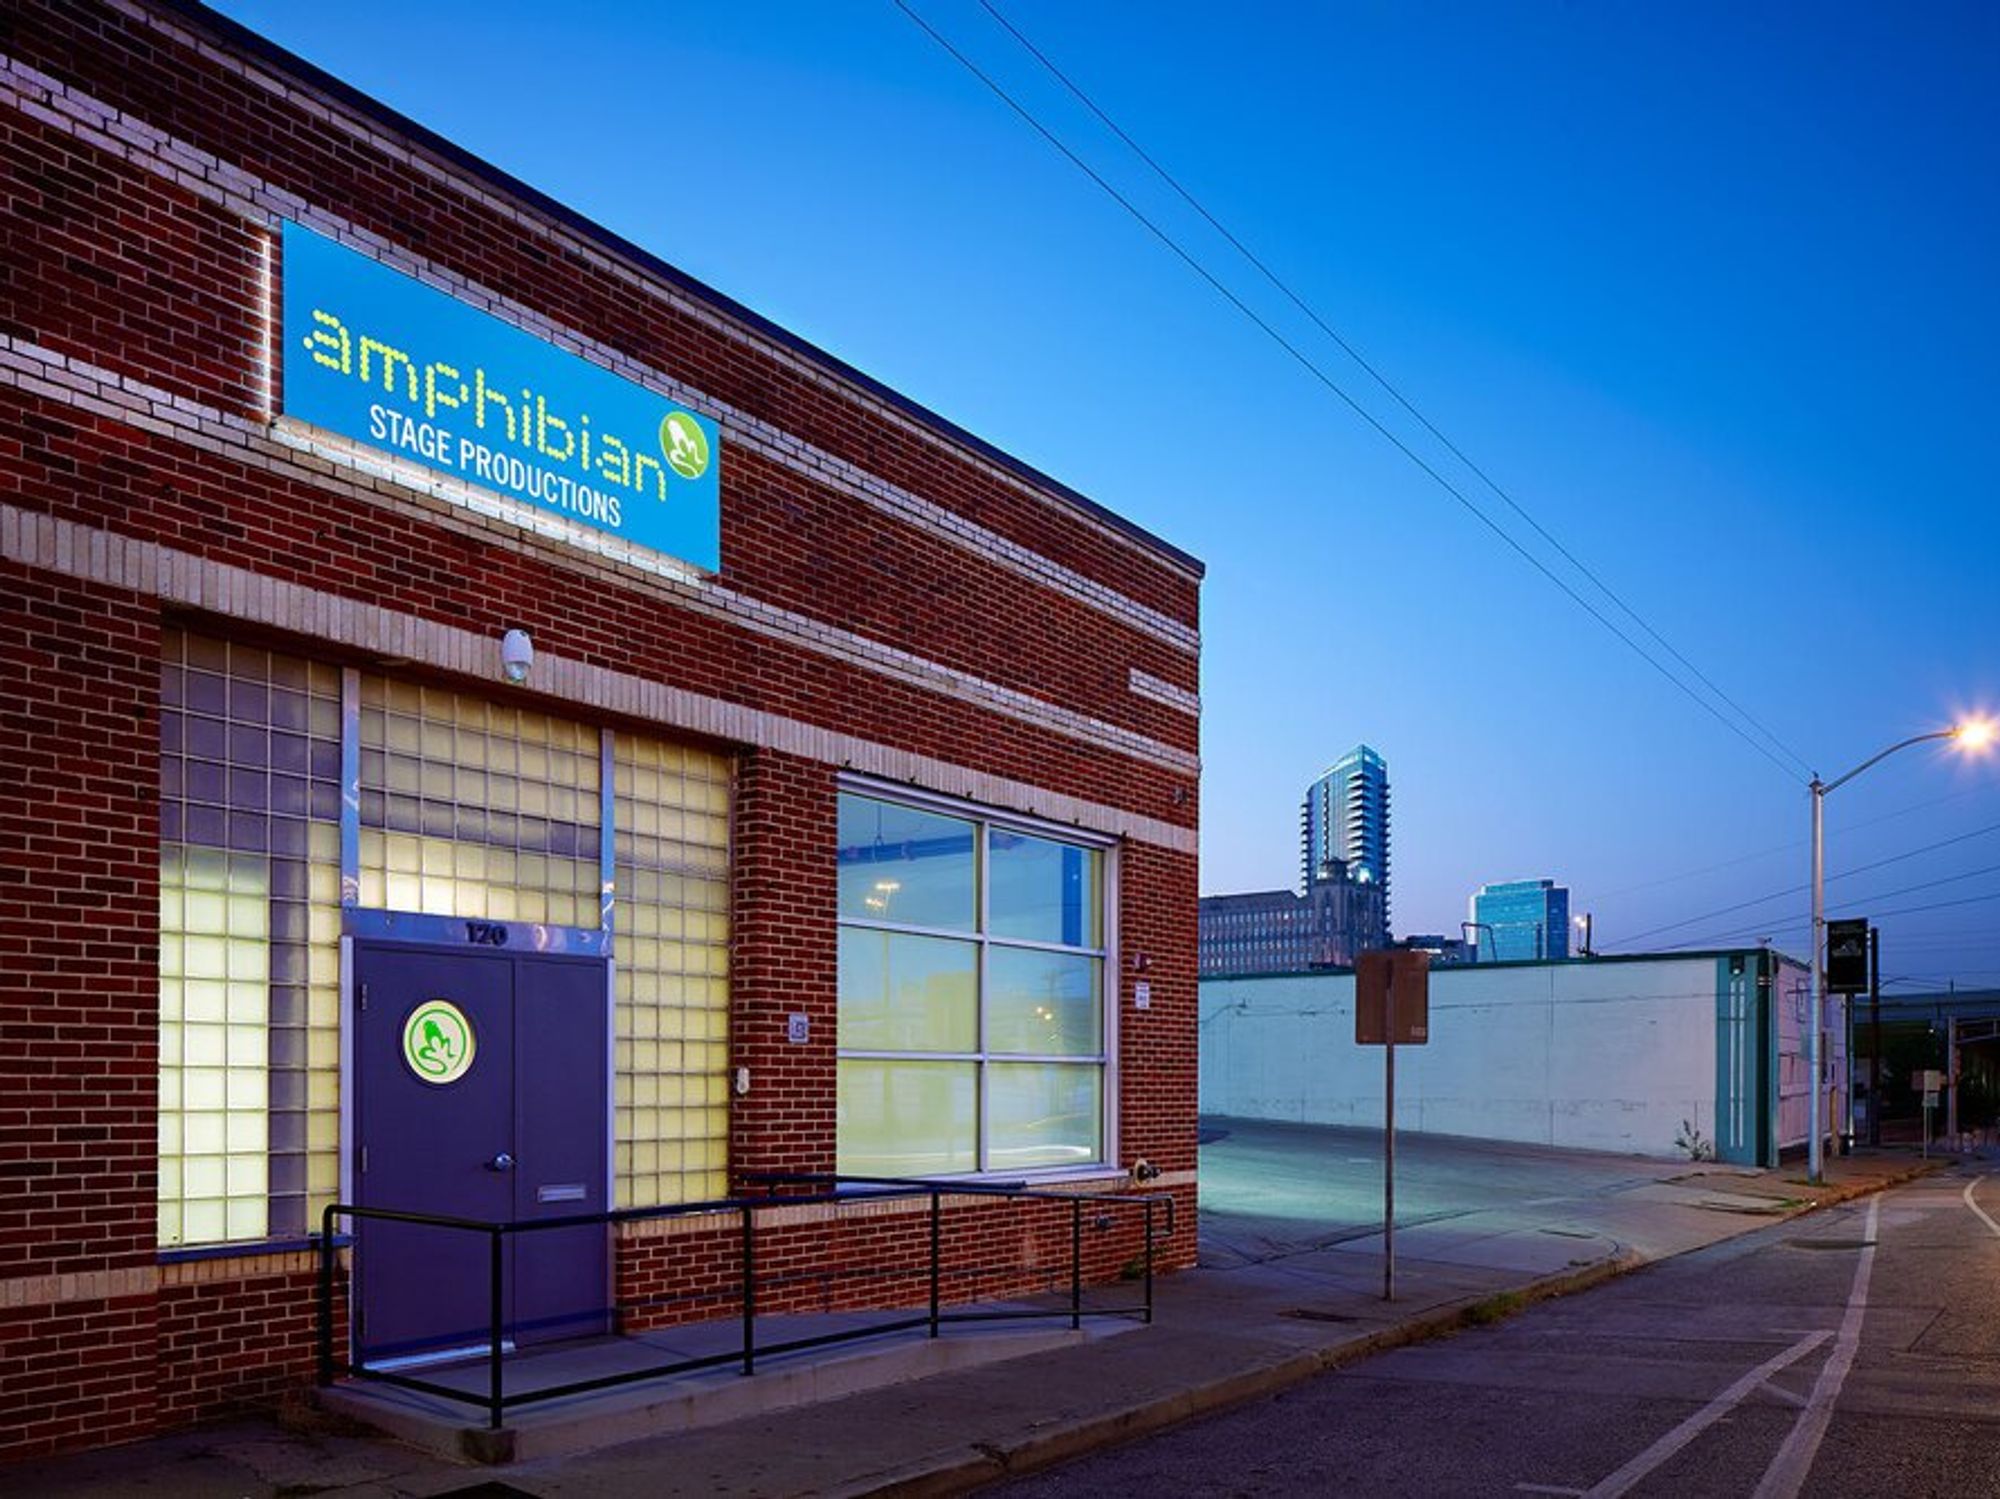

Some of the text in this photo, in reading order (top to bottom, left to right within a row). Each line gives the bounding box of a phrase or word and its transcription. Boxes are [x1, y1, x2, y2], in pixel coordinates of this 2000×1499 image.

[303, 308, 667, 502] amphibian
[370, 404, 622, 528] STAGE PRODUCTIONS
[465, 921, 509, 948] 120
